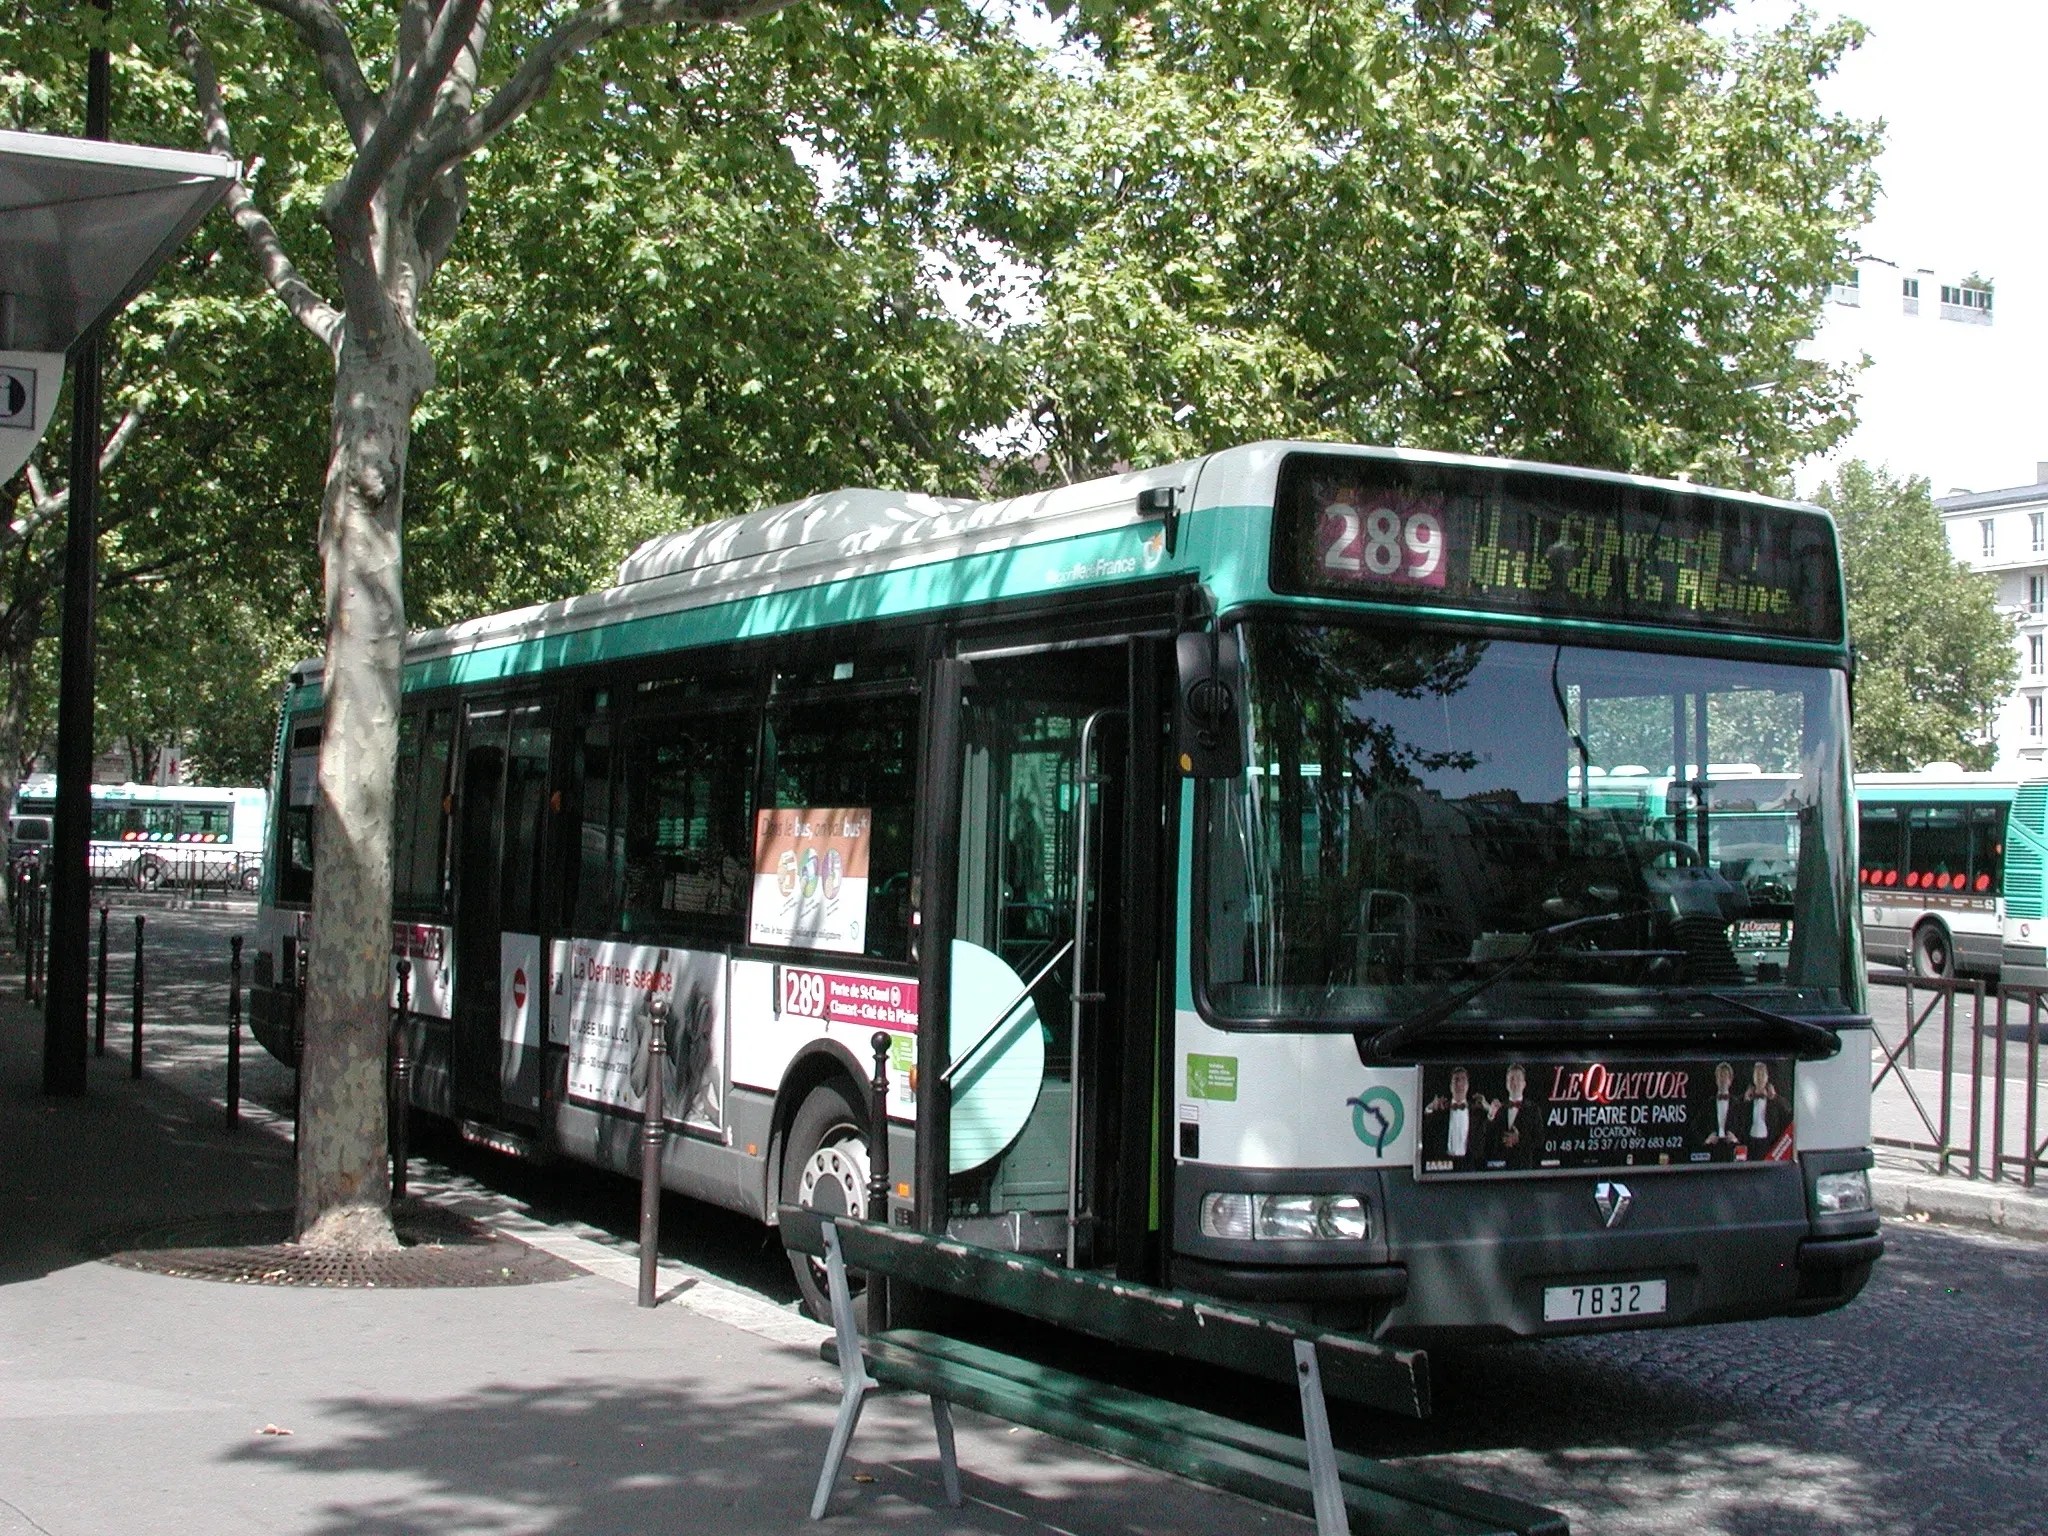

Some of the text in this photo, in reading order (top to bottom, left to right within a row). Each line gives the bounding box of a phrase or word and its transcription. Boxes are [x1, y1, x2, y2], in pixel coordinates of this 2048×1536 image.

[1325, 503, 1442, 578] 289
[573, 955, 585, 979] La
[786, 971, 825, 1017] 289
[850, 983, 859, 999] de
[877, 1005, 887, 1021] de
[888, 1007, 896, 1023] la
[1547, 1104, 1687, 1126] AU THEATRE DE PARIS
[1589, 1126, 1637, 1139] LOCATION
[1545, 1140, 1557, 1152] 01
[1560, 1140, 1572, 1152] 48
[1574, 1140, 1586, 1151] 74
[1588, 1139, 1599, 1151] 25
[1601, 1139, 1613, 1150] 37
[1648, 1137, 1665, 1149] 683
[1666, 1136, 1683, 1148] 622
[1572, 1284, 1641, 1316] 7832
